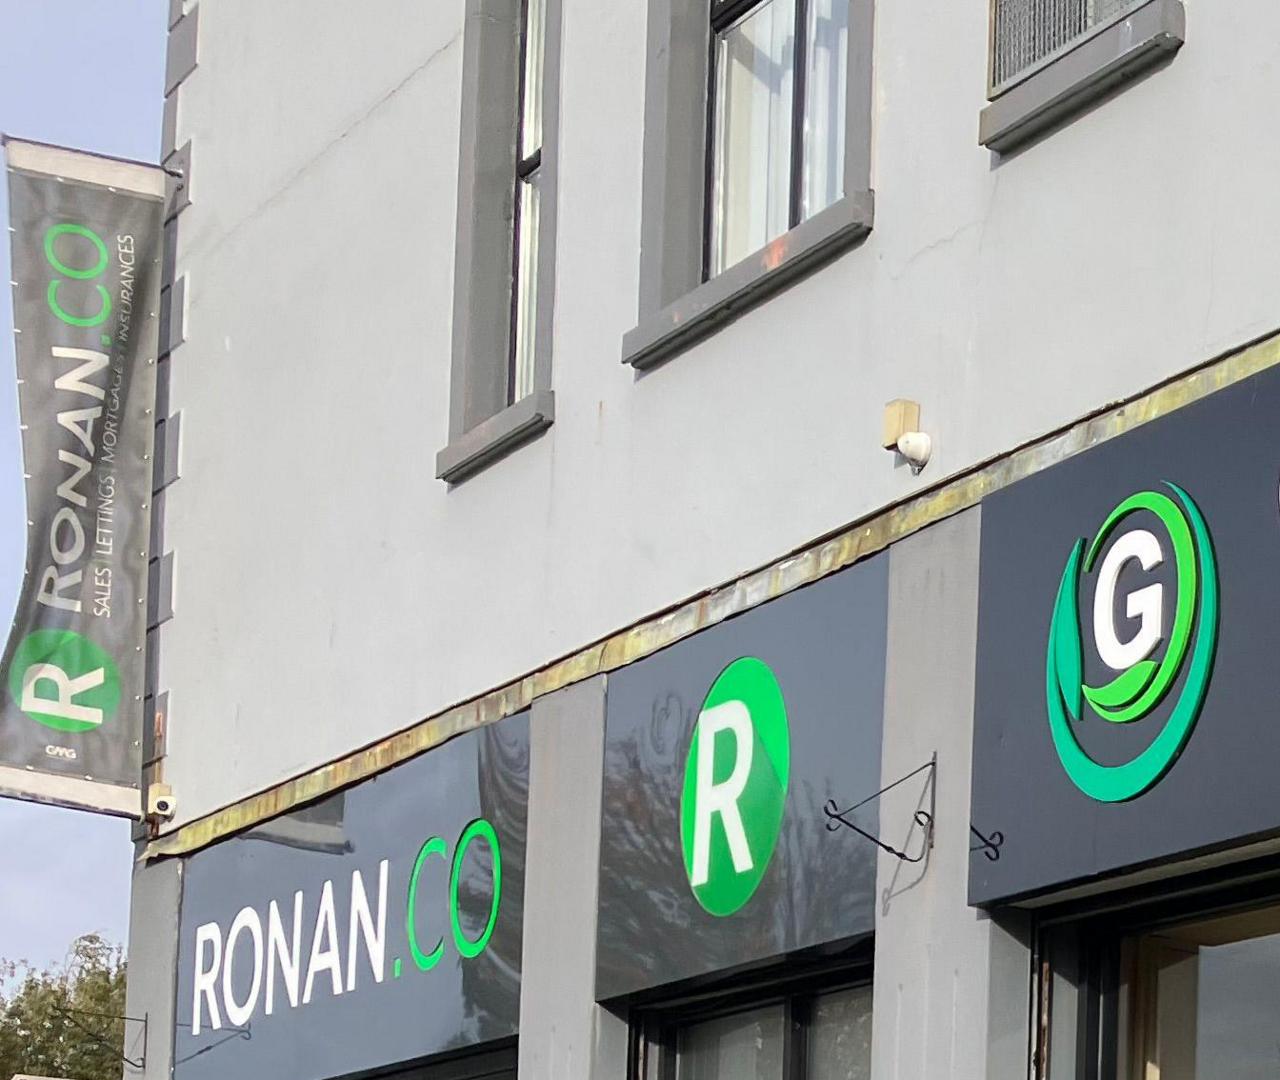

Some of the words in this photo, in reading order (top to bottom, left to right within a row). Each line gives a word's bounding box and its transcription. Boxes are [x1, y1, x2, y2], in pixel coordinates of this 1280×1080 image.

[117, 234, 134, 342] INSURANCES
[37, 223, 112, 612] RONAN.CO
[96, 476, 115, 555] LETTINGS
[93, 567, 112, 618] SALES
[1093, 529, 1164, 671] G
[21, 663, 104, 724] R
[691, 699, 754, 887] R
[192, 817, 501, 1036] RONAN.CO
